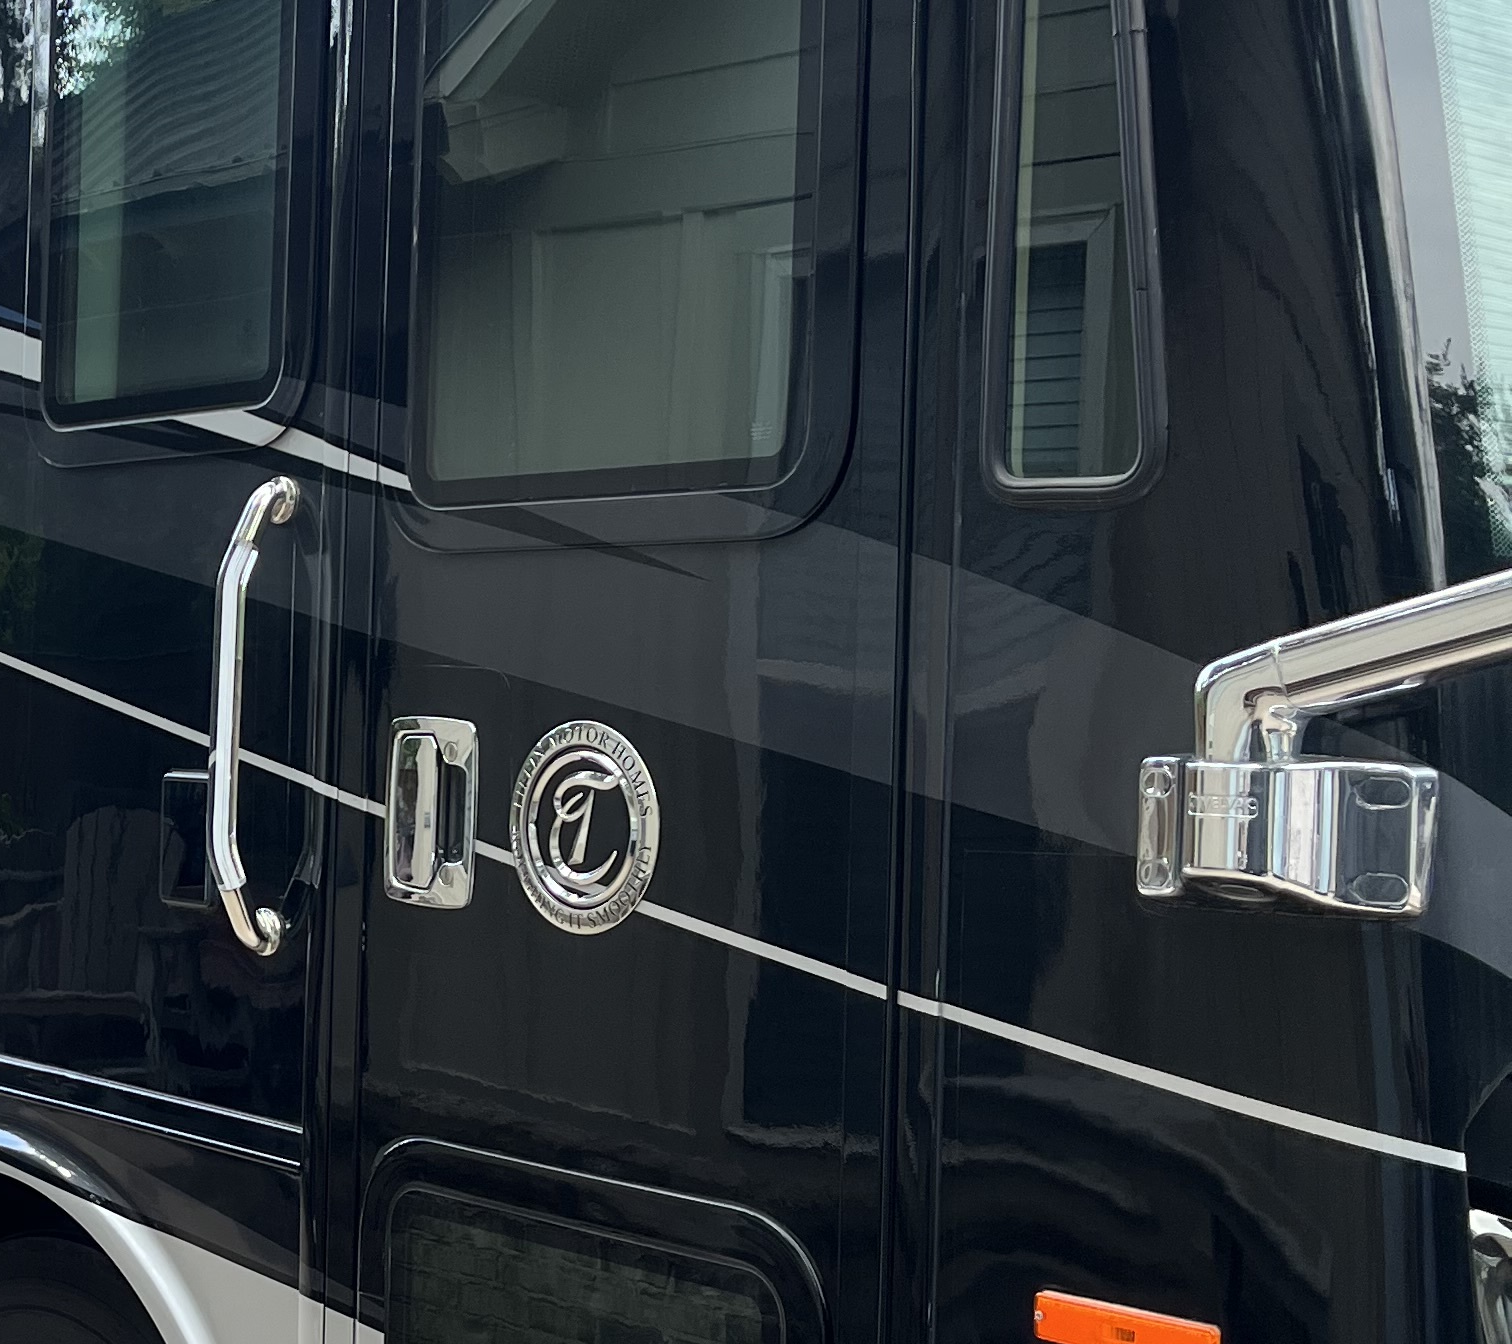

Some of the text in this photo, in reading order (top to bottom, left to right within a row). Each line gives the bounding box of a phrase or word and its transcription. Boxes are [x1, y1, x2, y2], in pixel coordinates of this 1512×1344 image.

[543, 726, 609, 751] MOTOR
[611, 739, 654, 818] HOMES
[567, 911, 583, 930] IT
[586, 845, 652, 928] SMOOTHLY
